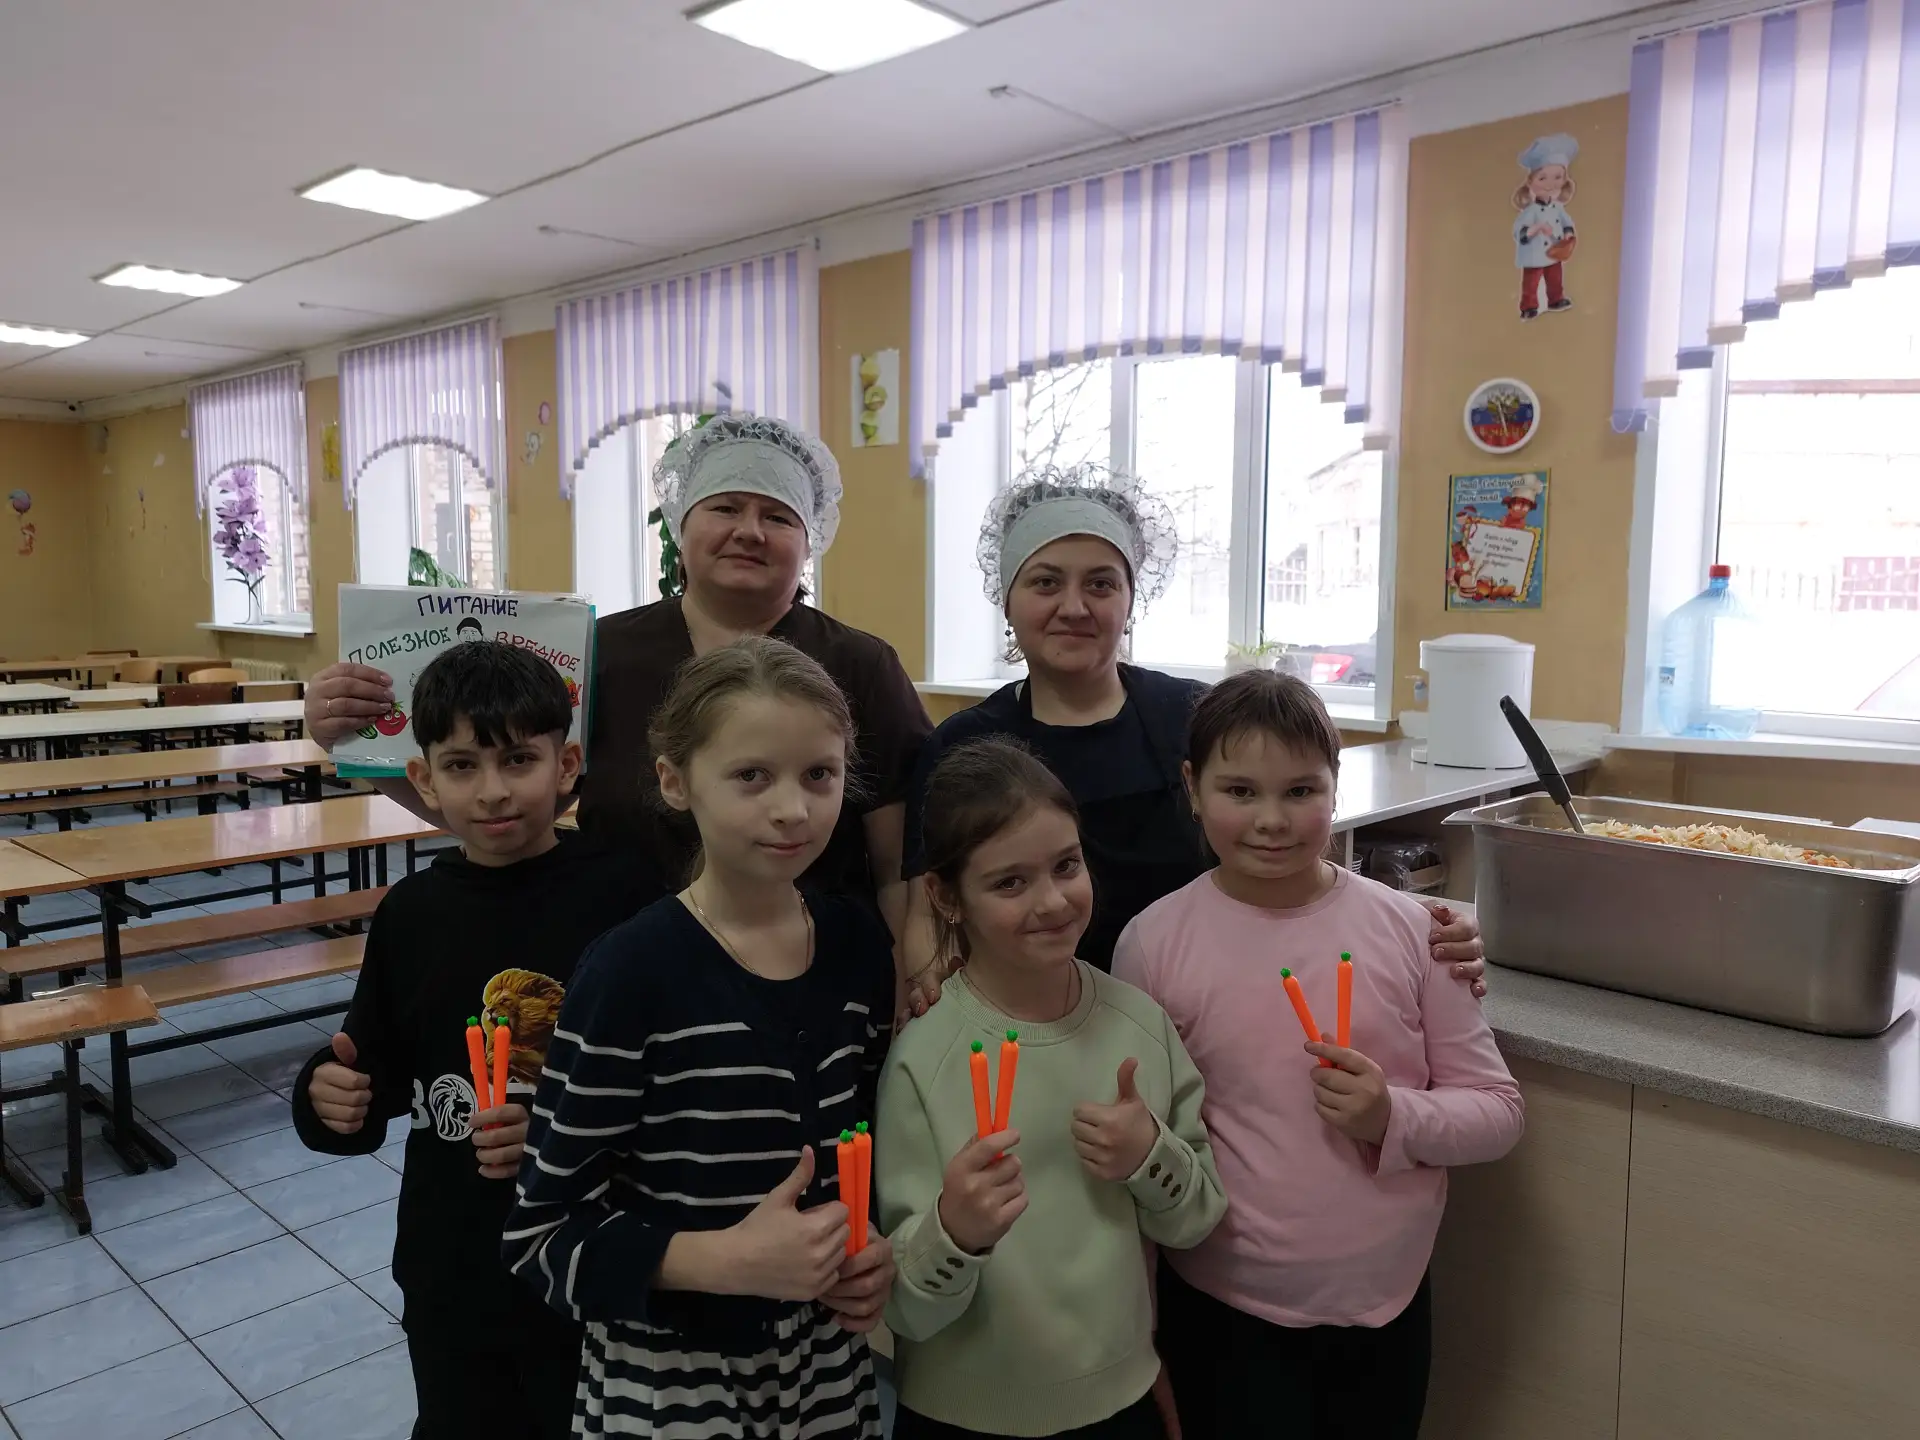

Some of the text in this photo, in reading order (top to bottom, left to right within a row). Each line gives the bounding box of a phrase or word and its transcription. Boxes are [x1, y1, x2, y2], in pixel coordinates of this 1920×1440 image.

[417, 594, 518, 617] ПИТАНИЕ
[348, 626, 580, 672] ПОЛЕЗНОЕ ВРЕДНОЕ
